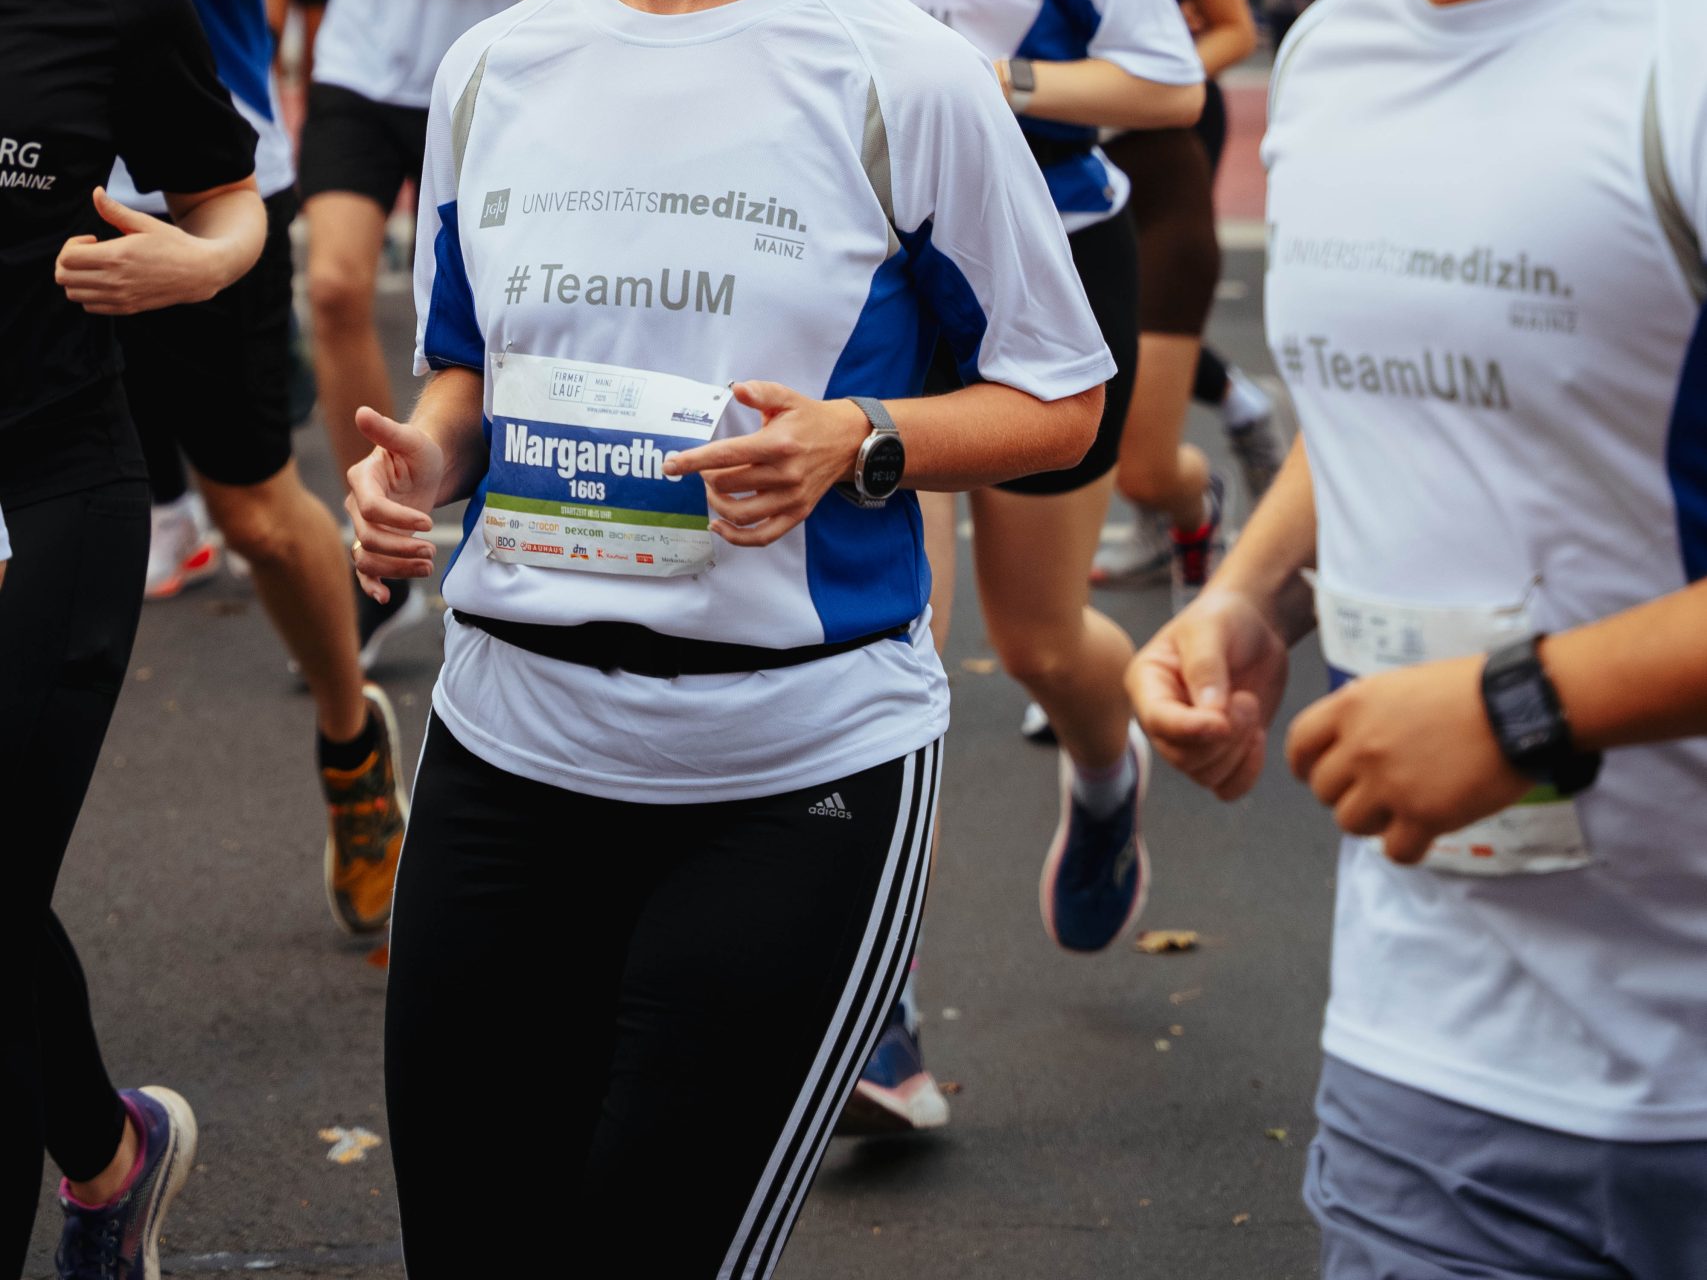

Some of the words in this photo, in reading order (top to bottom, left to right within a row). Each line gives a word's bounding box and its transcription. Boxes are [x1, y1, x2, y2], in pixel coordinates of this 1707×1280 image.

[0, 170, 56, 190] MAINZ
[754, 237, 804, 260] MAINZ
[555, 372, 583, 383] FIRMEN
[552, 383, 581, 398] LAUF
[569, 479, 606, 500] 1603
[497, 536, 516, 548] BDO
[527, 544, 563, 553] BAUHAUS
[573, 544, 587, 554] dm
[808, 806, 853, 820] adidas
